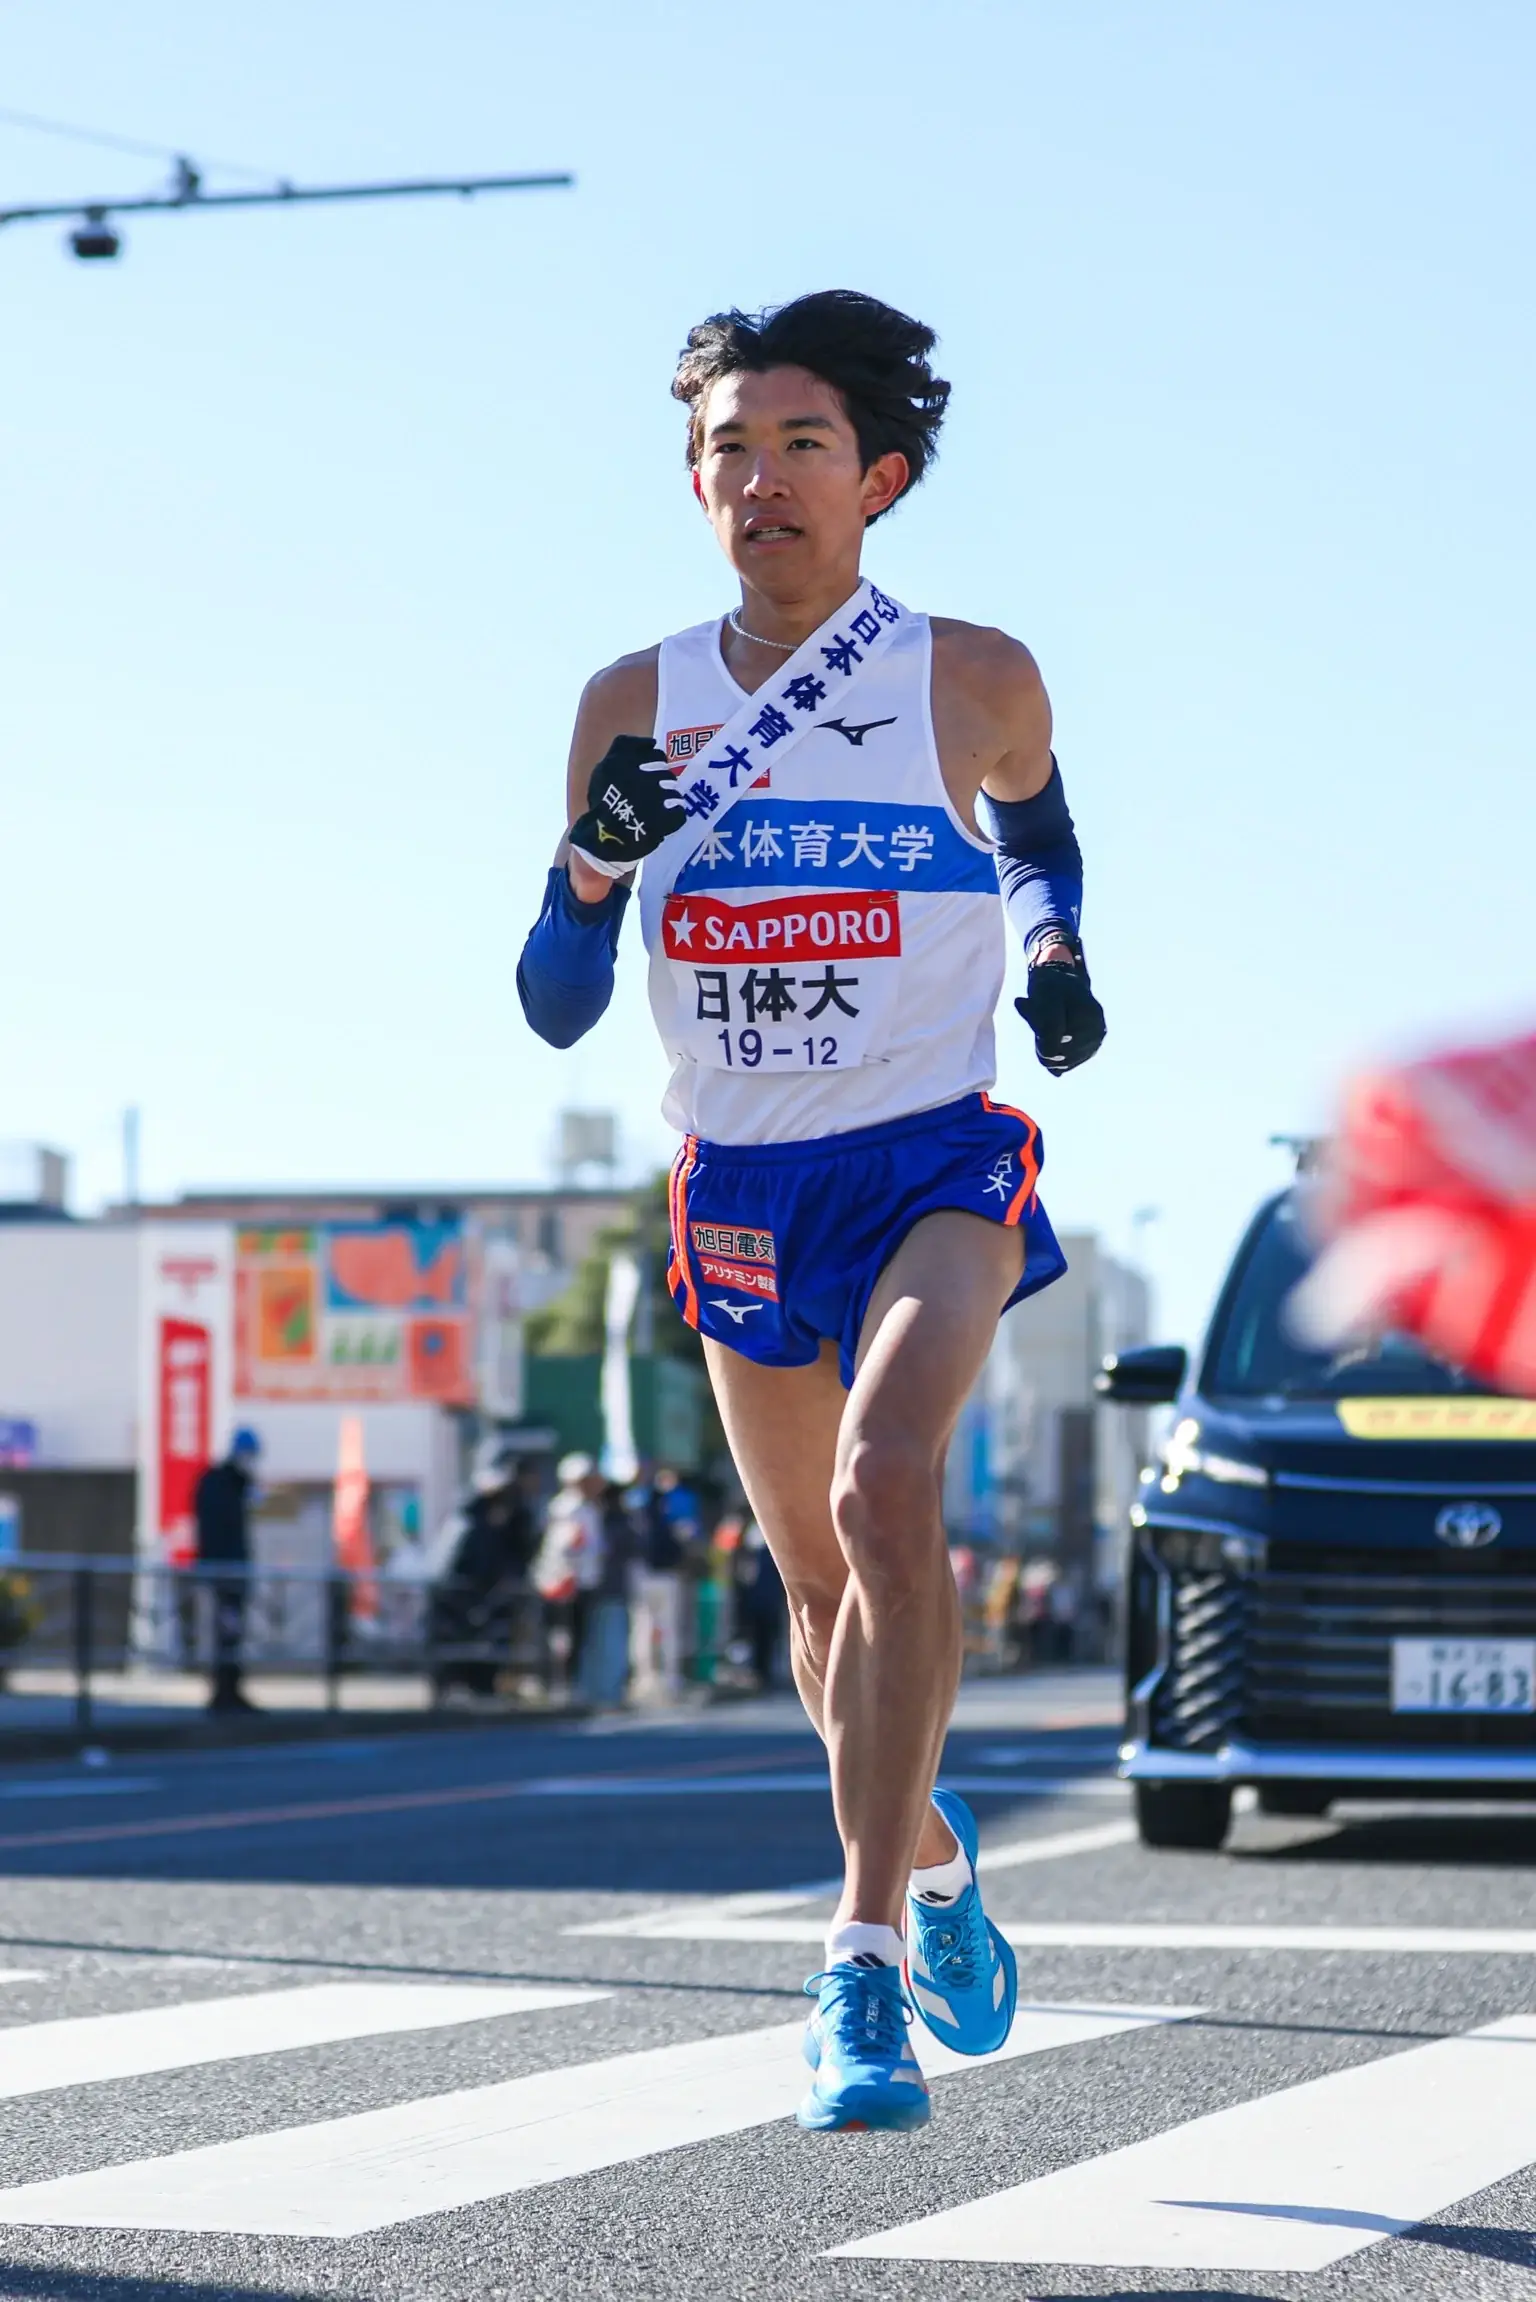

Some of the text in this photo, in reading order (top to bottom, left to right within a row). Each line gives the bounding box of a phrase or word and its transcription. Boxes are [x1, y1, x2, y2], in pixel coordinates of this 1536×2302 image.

[683, 609, 881, 820] 日本体育大学
[669, 729, 719, 758] 旭日
[602, 784, 647, 842] 日体大
[689, 820, 935, 872] 本体育大学
[704, 908, 891, 950] SAPPORO
[693, 965, 861, 1023] 日体大
[695, 1227, 775, 1260] 旭日電気
